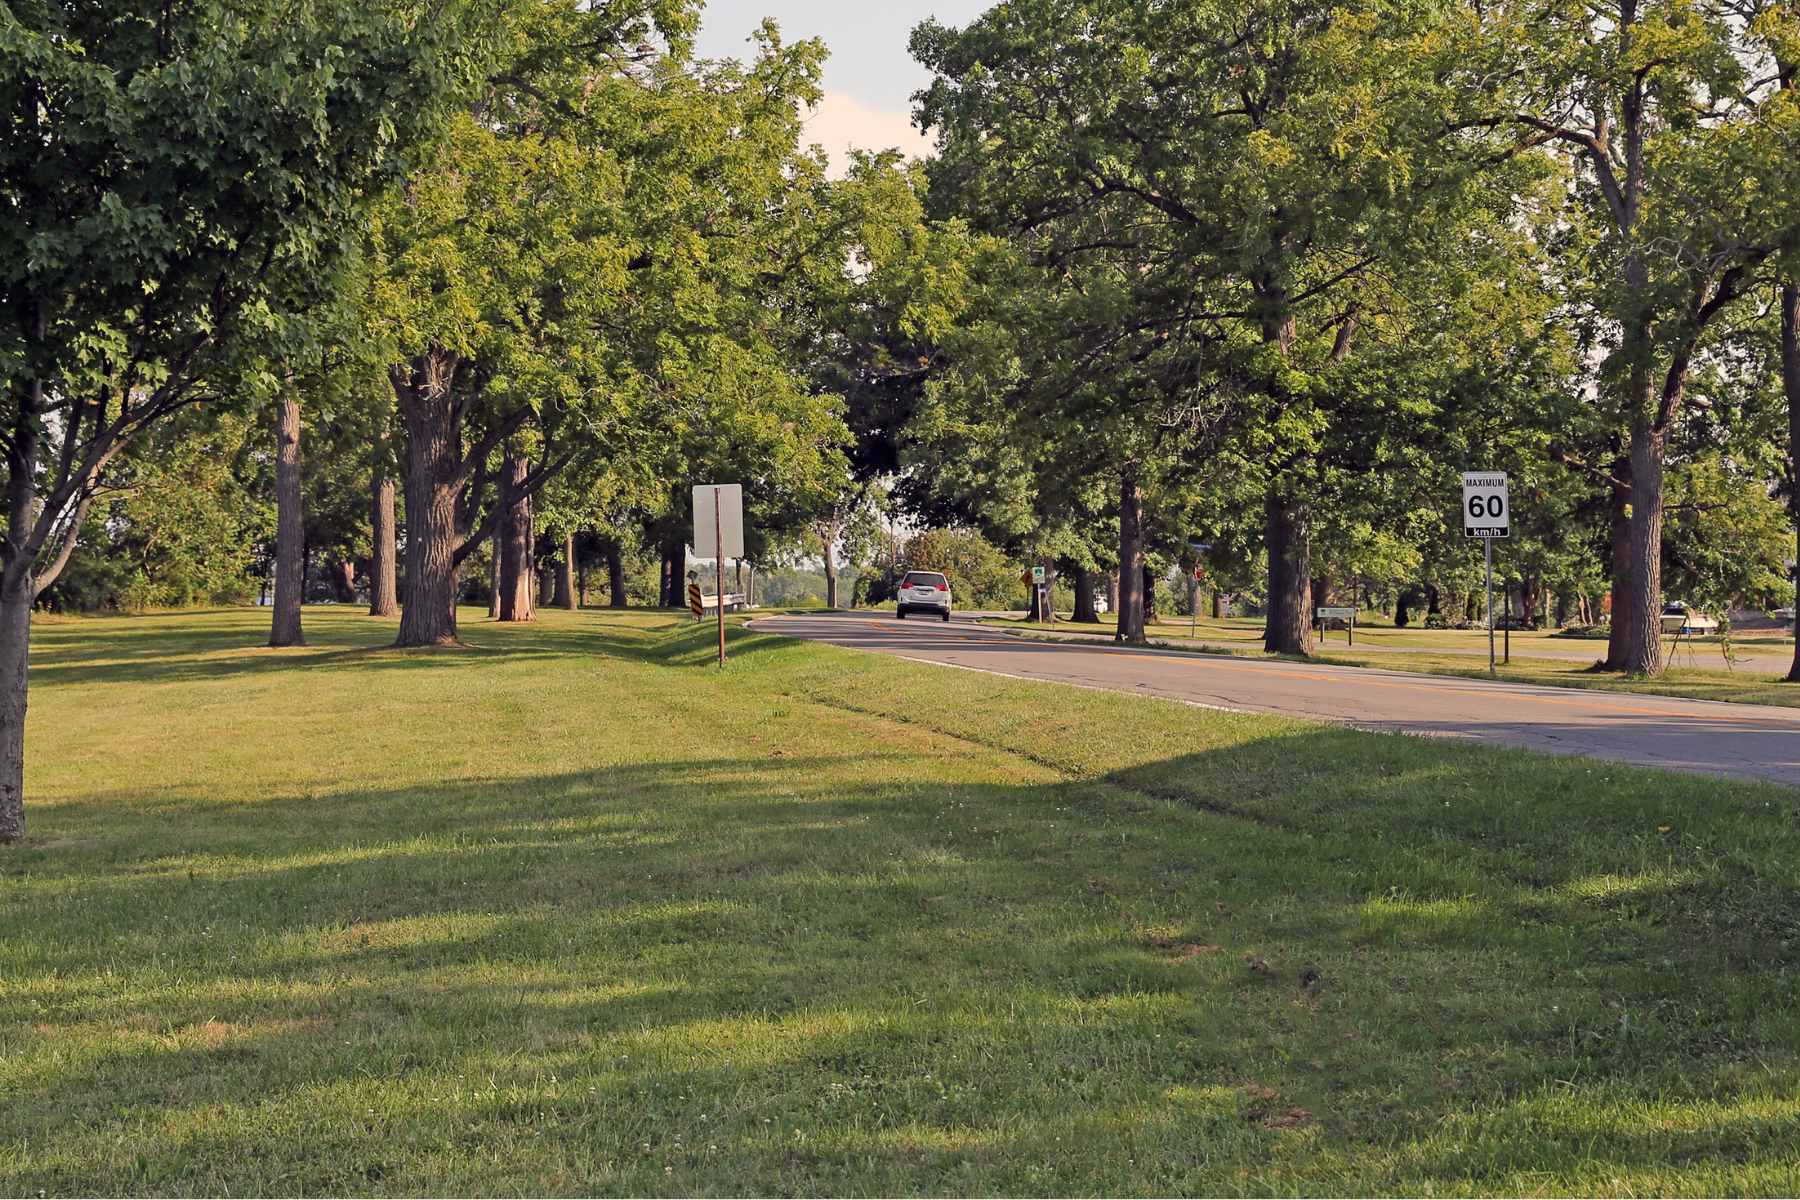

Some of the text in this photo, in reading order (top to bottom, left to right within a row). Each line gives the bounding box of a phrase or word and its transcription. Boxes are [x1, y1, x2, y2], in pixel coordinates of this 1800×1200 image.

[1466, 478, 1504, 487] MAXIMUM
[1468, 495, 1503, 518] 60
[1473, 527, 1501, 536] km/h
